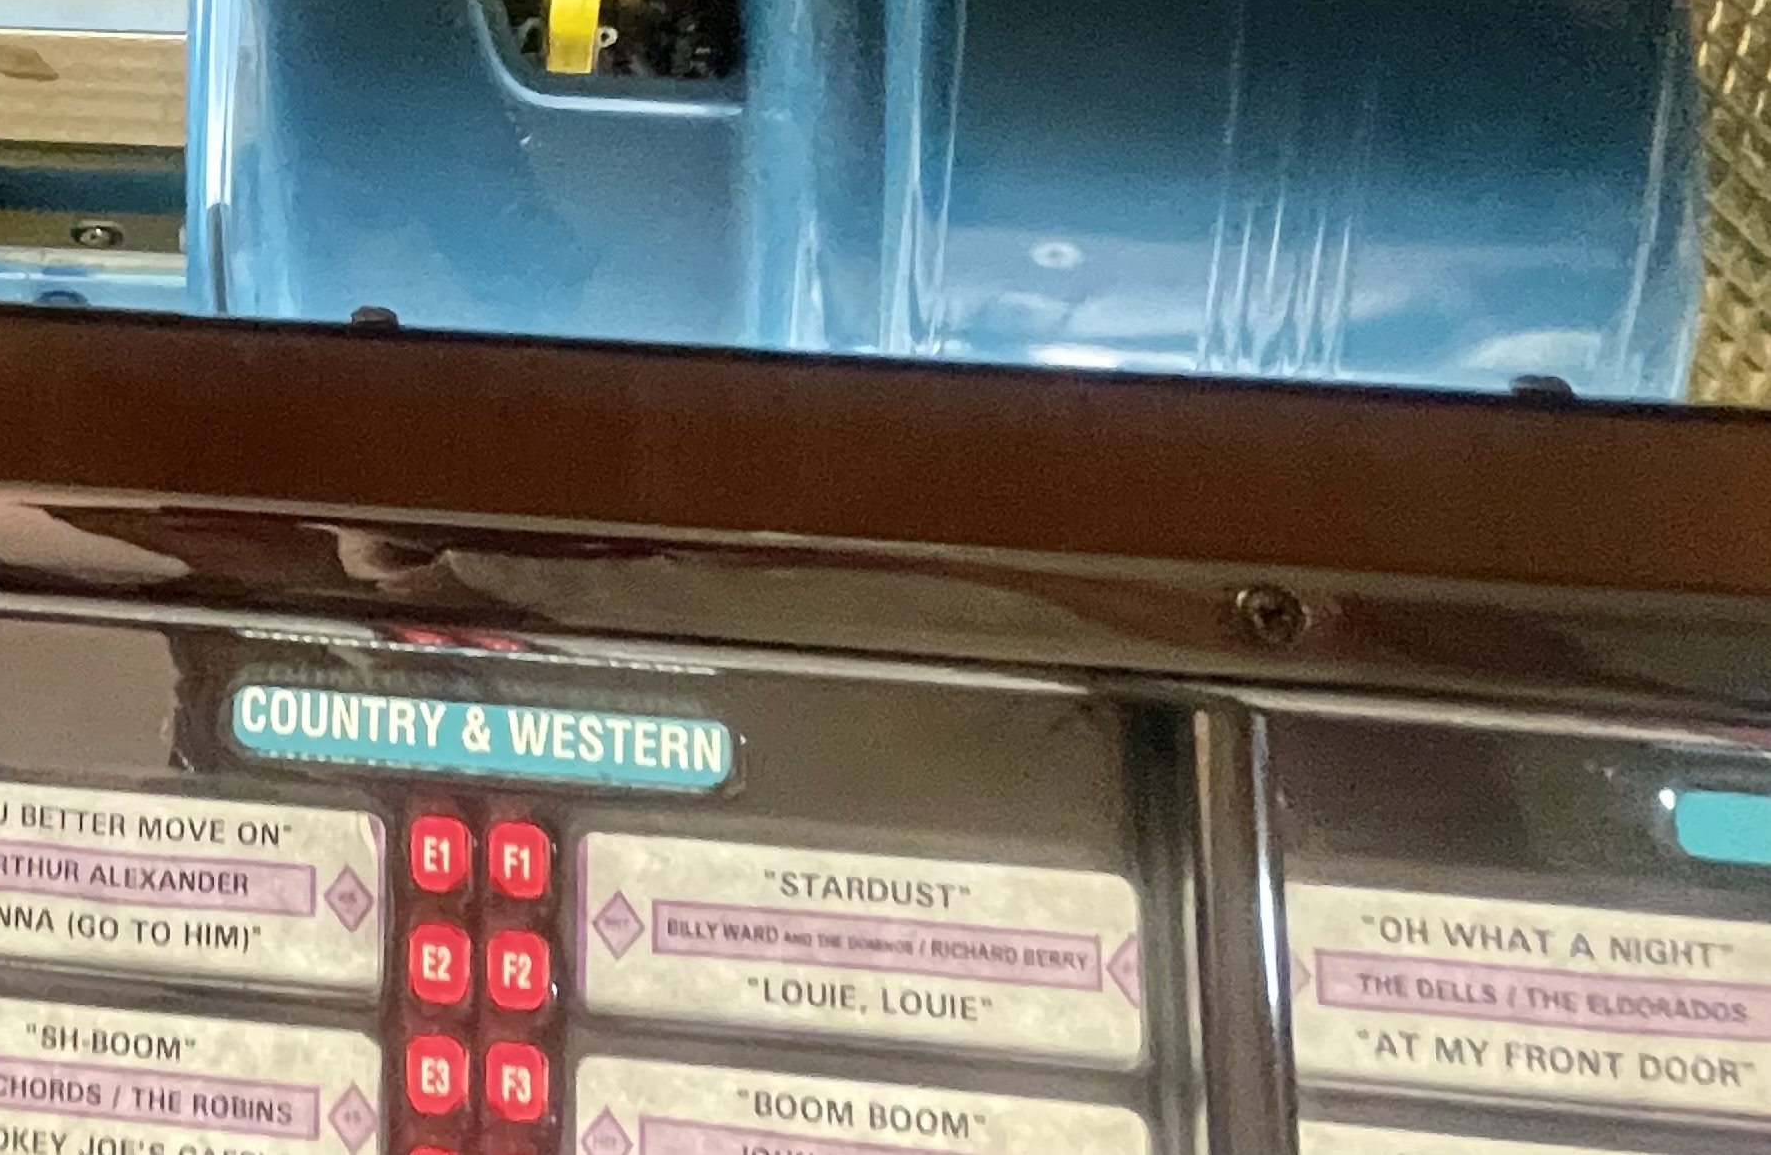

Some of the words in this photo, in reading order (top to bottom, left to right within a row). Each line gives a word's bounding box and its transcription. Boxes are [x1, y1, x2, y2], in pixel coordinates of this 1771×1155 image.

[241, 685, 447, 748] COUNTRY
[461, 704, 491, 753] &
[508, 708, 722, 773] WESTERN
[20, 804, 126, 839] BETTER
[137, 816, 227, 844] MOVE
[237, 819, 293, 847] ON"
[423, 835, 450, 874] E1
[503, 844, 531, 882] F1
[89, 862, 250, 897] ALEXANDER
[764, 869, 971, 910] "STARDUST"
[67, 909, 120, 943] (GO
[129, 919, 171, 947] TO
[183, 923, 261, 953] HIM)"
[667, 917, 718, 939] BILLY
[722, 922, 778, 942] WARD
[931, 940, 1018, 965] RICHARD
[1023, 948, 1089, 969] BERRY
[1441, 920, 1552, 957] WHAT
[1569, 932, 1595, 959] A
[422, 943, 452, 982] E2
[502, 950, 533, 990] F2
[747, 977, 868, 1014] "LOUIE,
[881, 986, 993, 1022] LOUIE"
[1356, 971, 1406, 997] THE
[1417, 978, 1497, 1006] DELLS
[1526, 986, 1576, 1012] THE
[421, 1055, 450, 1096] E3
[1434, 1035, 1489, 1067] MY
[1505, 1045, 1623, 1079] FRONT
[501, 1064, 532, 1104] F3
[131, 1086, 182, 1113] THE
[192, 1092, 294, 1126] ROBINS
[737, 1089, 854, 1127] "BOOM
[869, 1101, 986, 1139] BOOM"
